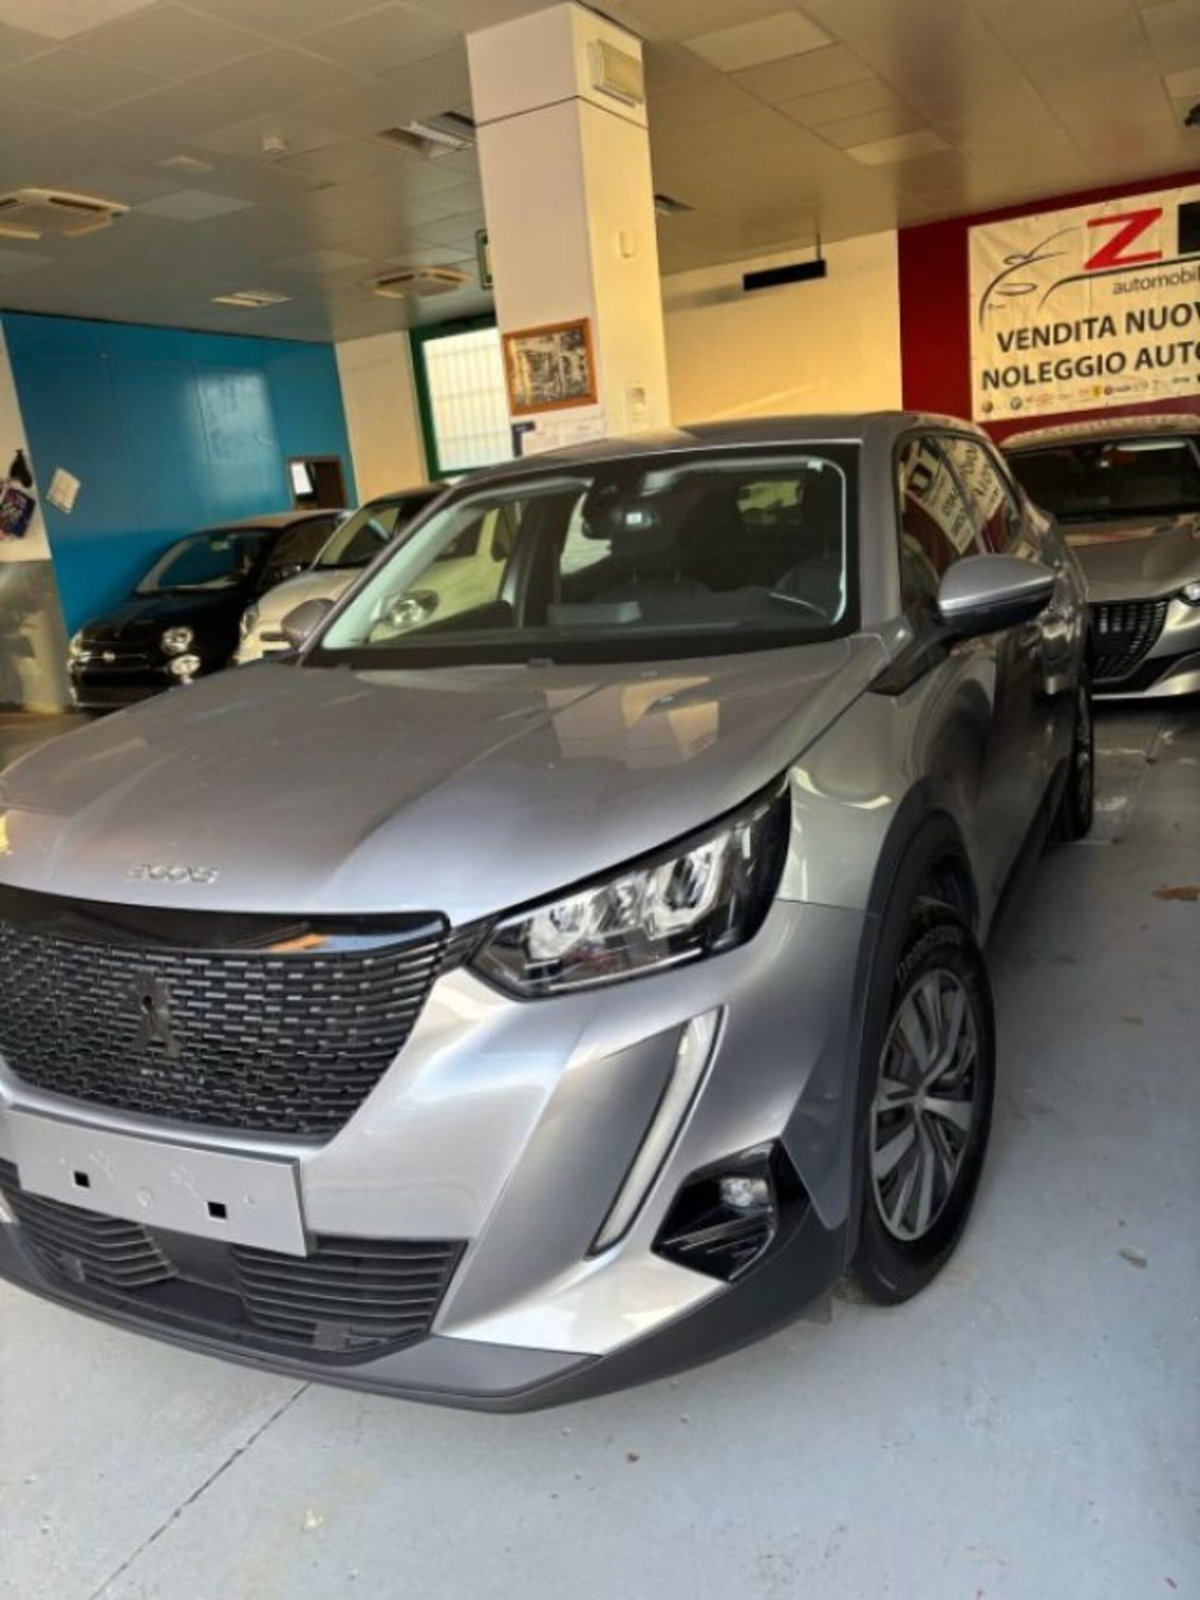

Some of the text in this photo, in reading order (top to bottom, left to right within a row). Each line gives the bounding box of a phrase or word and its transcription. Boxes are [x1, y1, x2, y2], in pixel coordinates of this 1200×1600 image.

[998, 315, 1116, 353] VENDITA
[982, 340, 1200, 391] NOLEGGIO AUT
